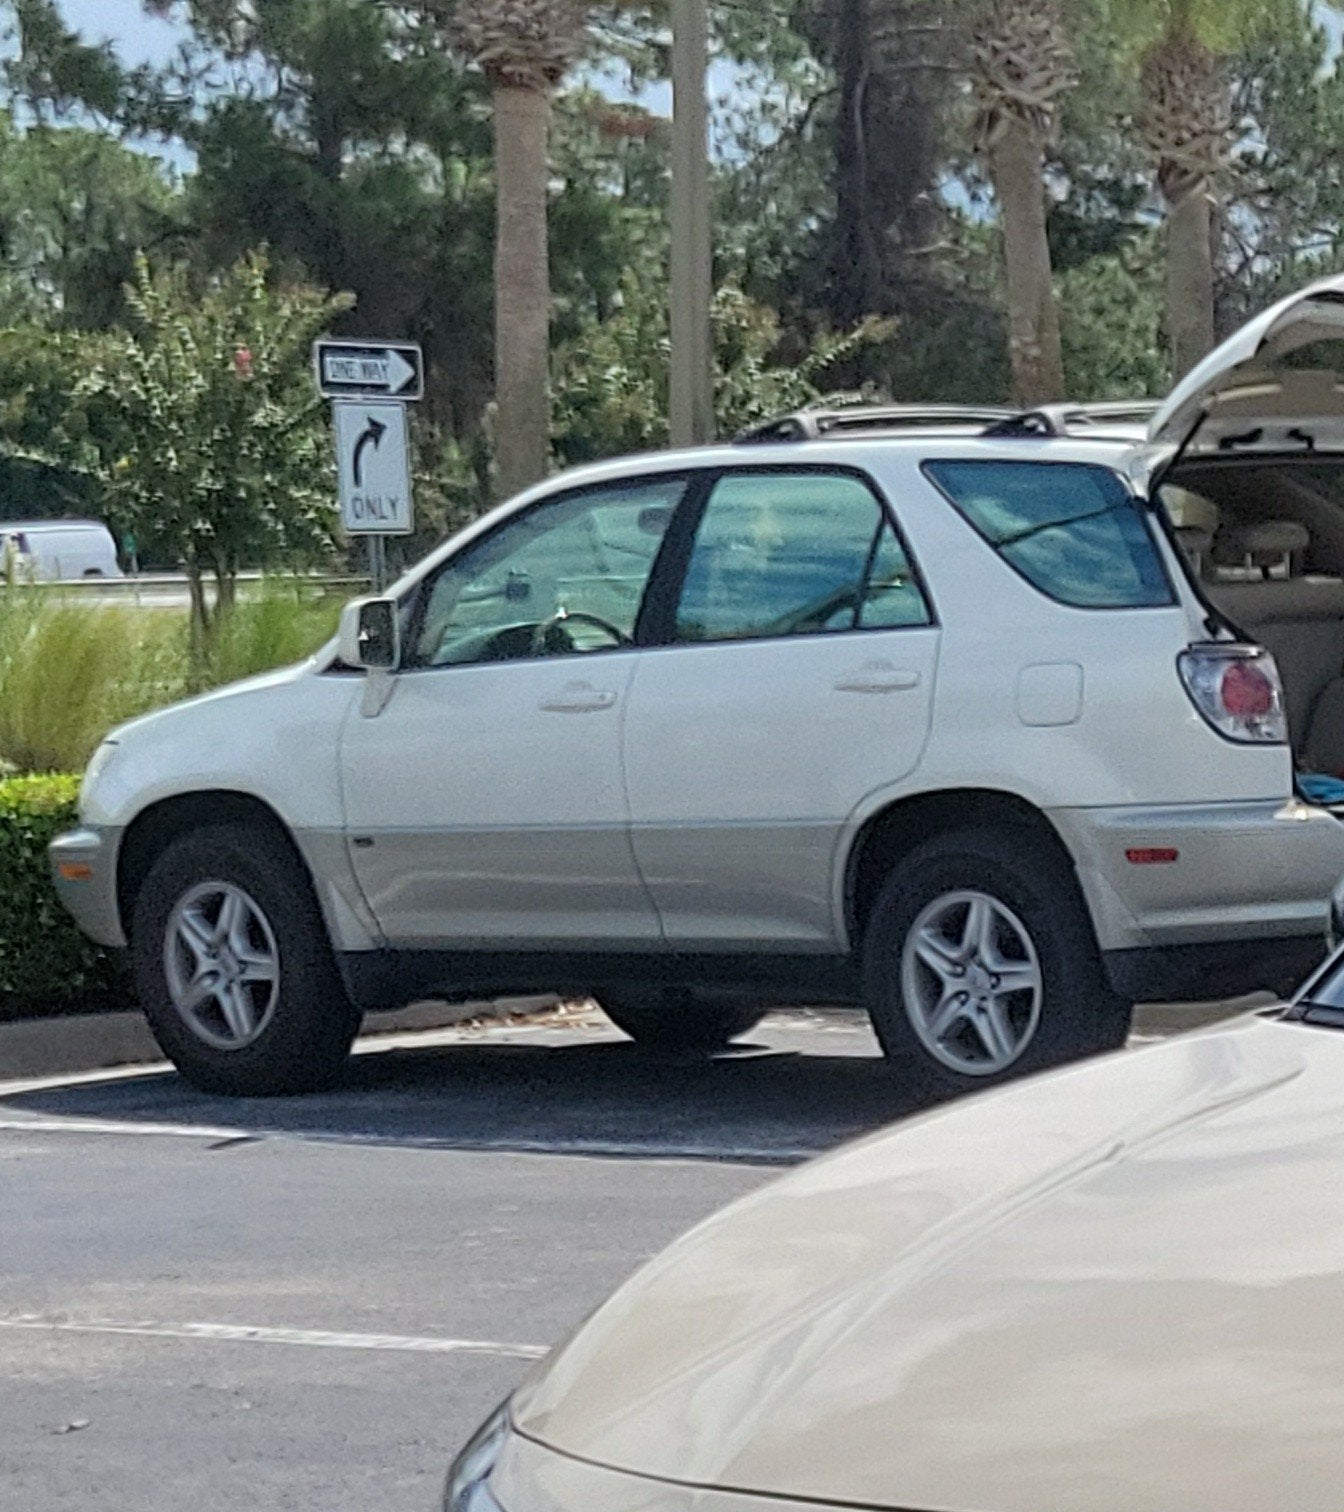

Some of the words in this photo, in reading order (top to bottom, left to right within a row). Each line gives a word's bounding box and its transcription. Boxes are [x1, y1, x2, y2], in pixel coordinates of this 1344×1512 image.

[329, 359, 357, 380] ONE
[361, 361, 388, 382] WAY
[352, 496, 400, 520] ONLY
